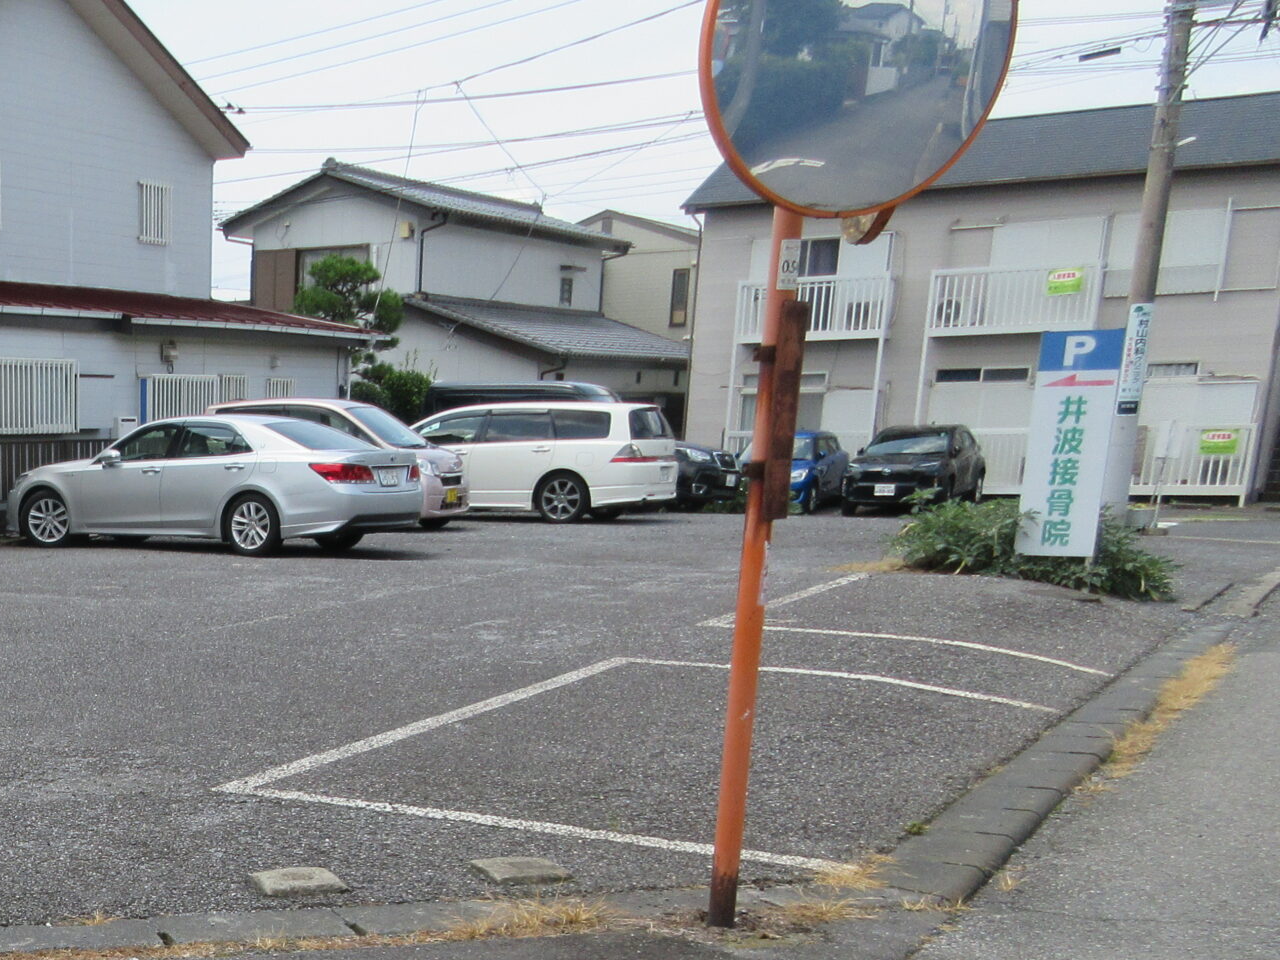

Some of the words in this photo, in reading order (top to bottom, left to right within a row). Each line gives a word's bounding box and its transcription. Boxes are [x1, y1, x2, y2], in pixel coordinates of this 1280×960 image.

[1062, 335, 1097, 367] P
[1040, 396, 1087, 546] 井波接骨院
